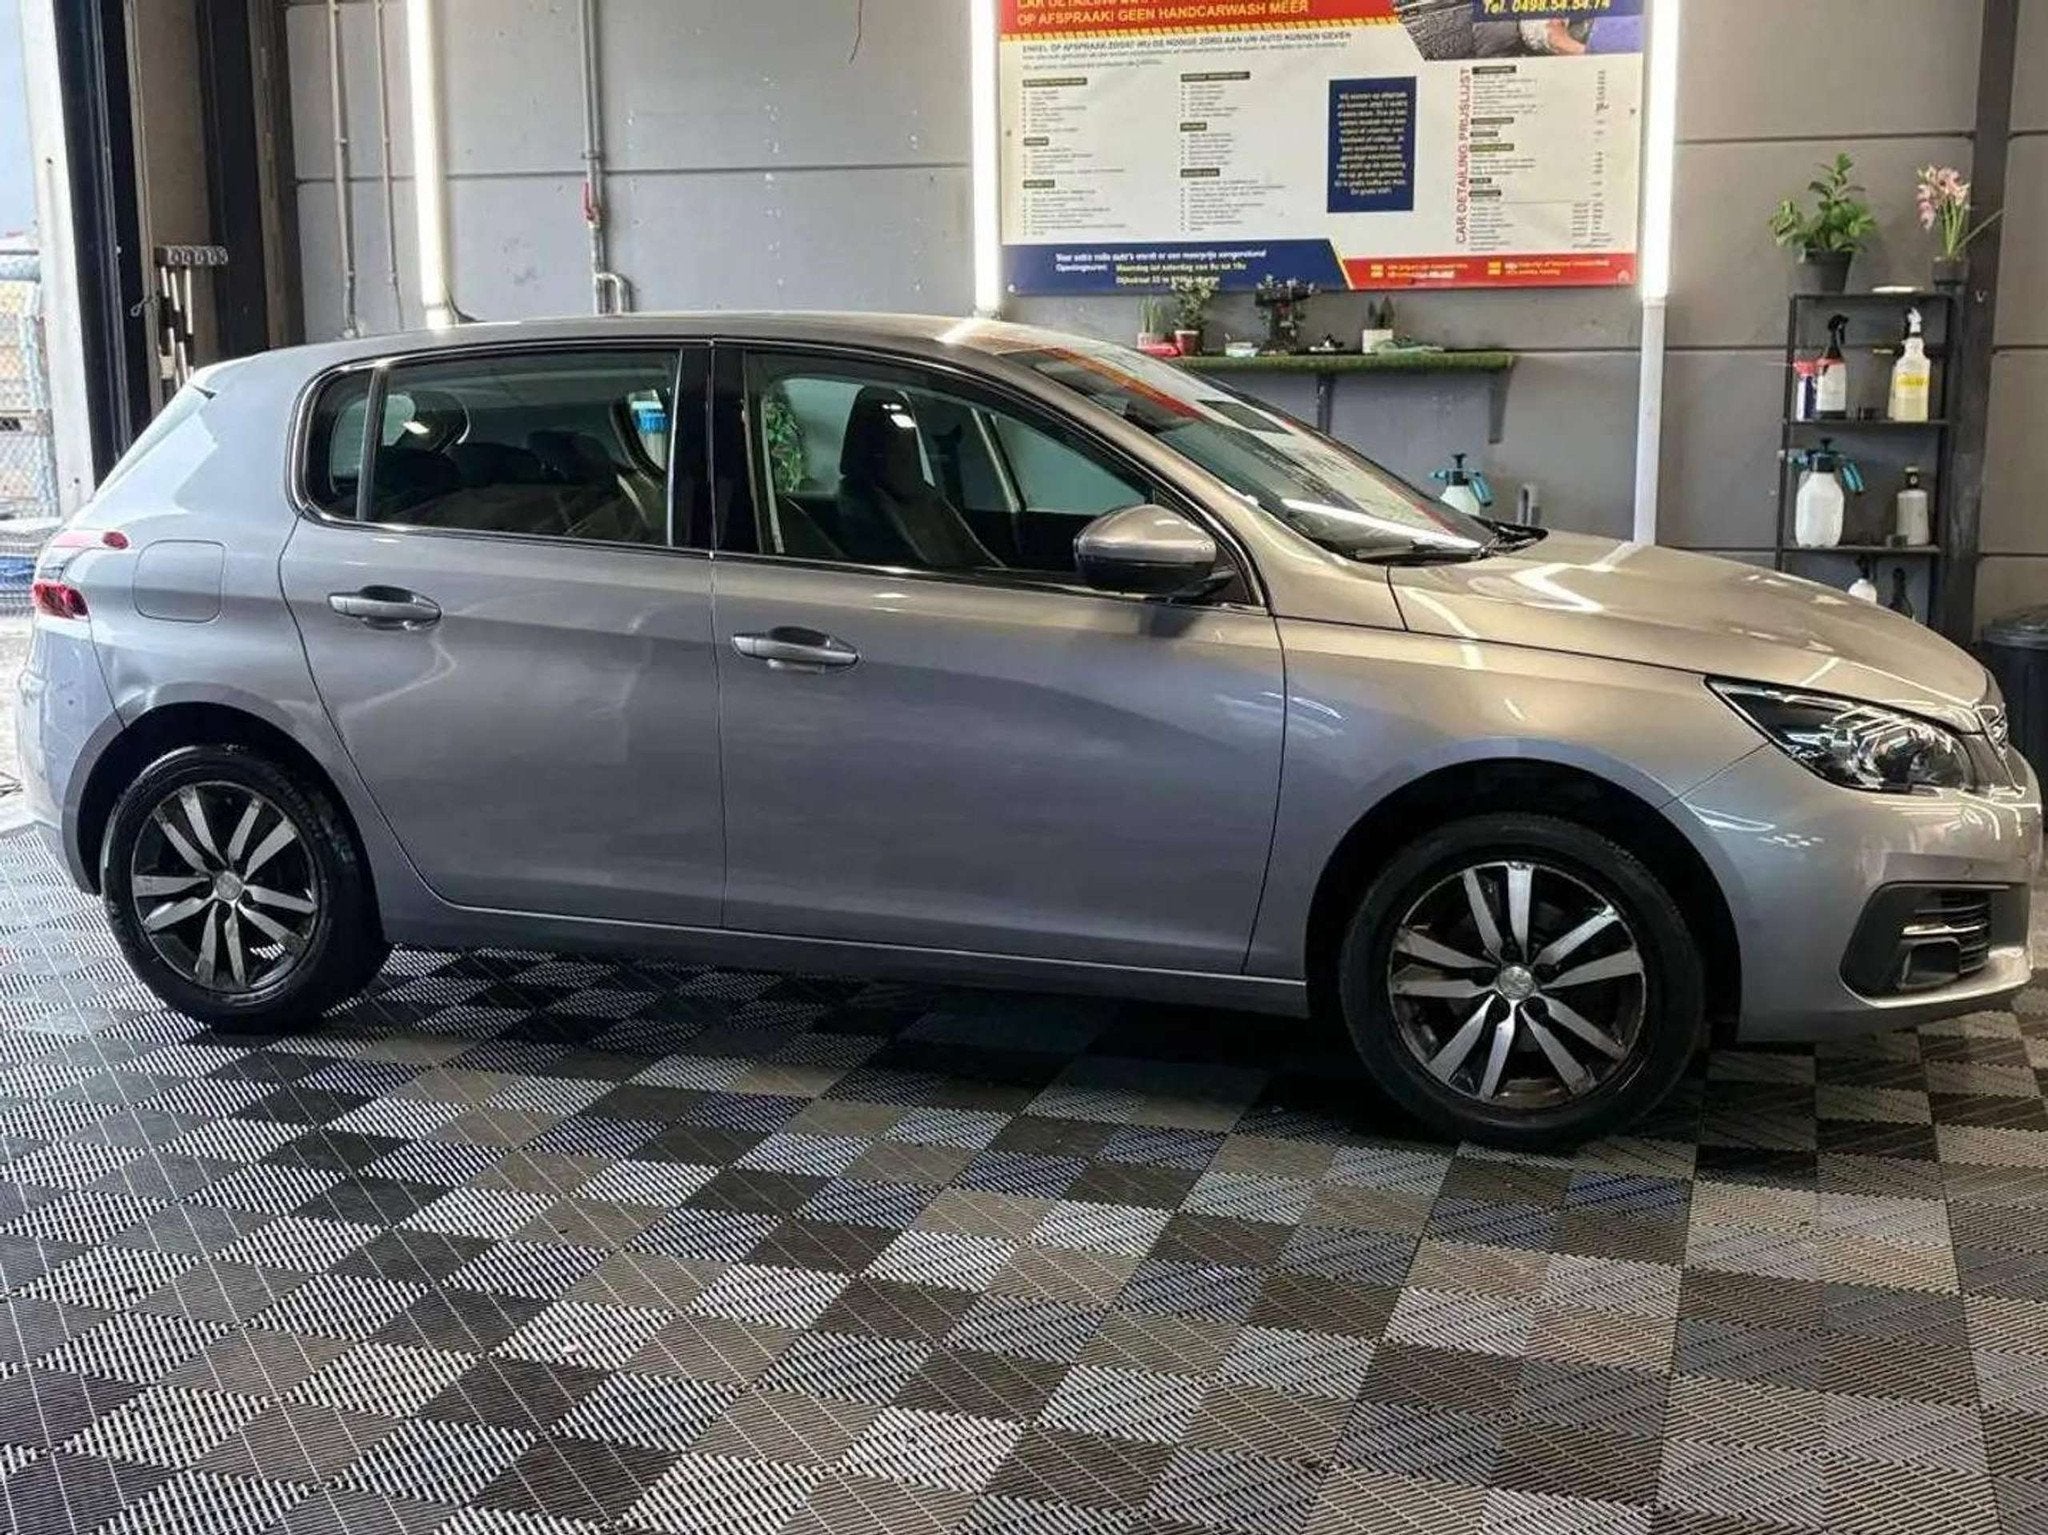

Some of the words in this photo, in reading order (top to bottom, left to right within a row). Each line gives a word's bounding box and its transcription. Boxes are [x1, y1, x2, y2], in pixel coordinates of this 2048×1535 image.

[1017, 13, 1035, 25] OP
[1118, 8, 1154, 22] GEEN
[1158, 3, 1266, 19] HANDCARWASH
[1269, 0, 1309, 14] MEER
[1459, 67, 1471, 141] PRIJSLIJST
[1456, 143, 1469, 213] DETAILING
[1456, 217, 1467, 244] CAR
